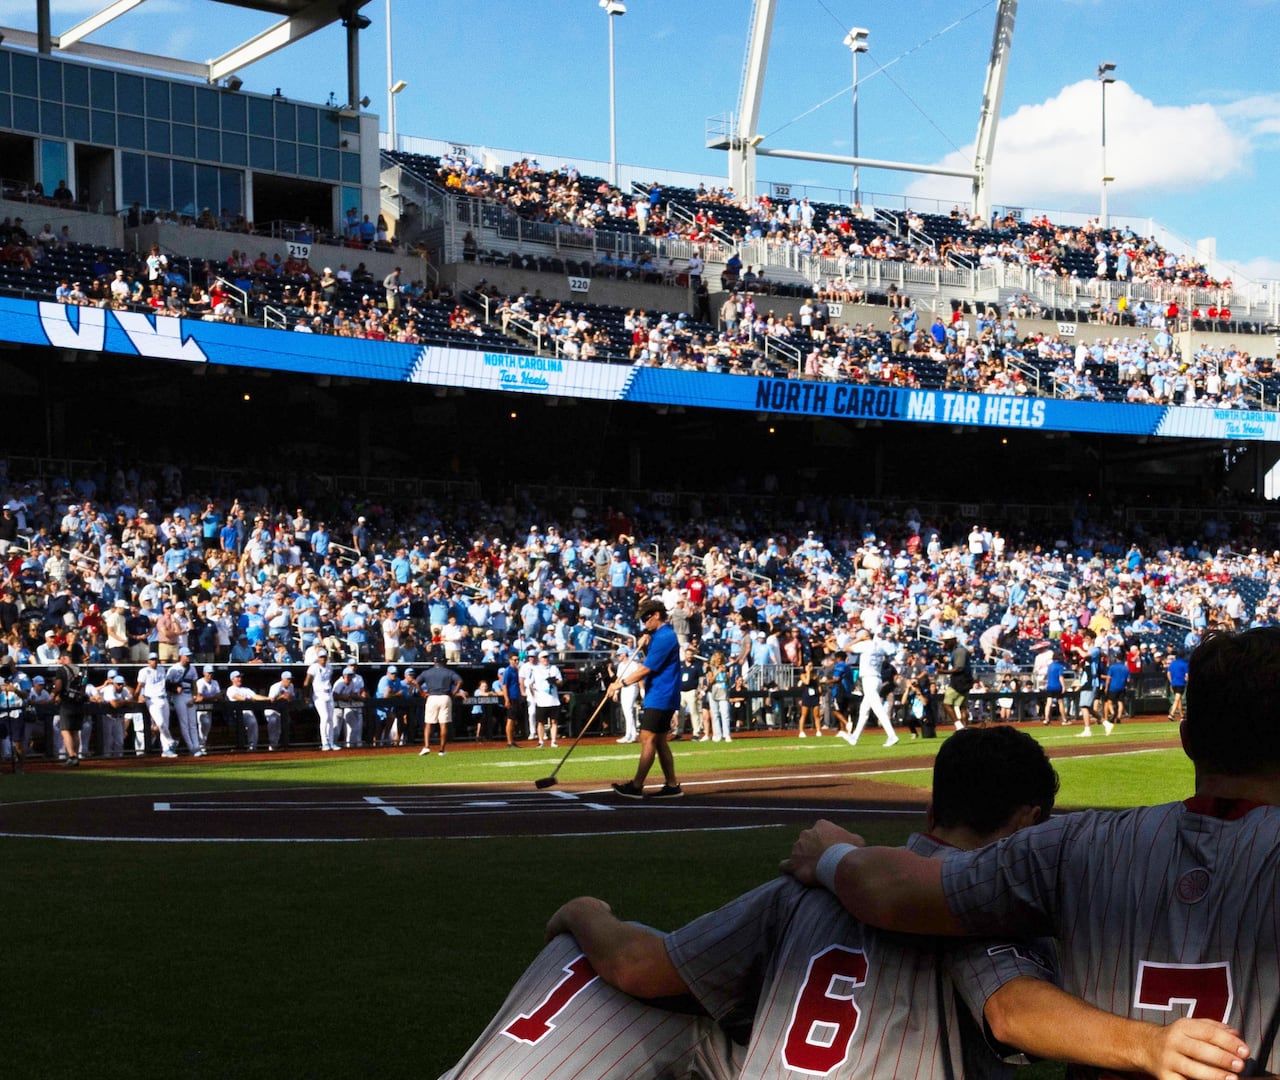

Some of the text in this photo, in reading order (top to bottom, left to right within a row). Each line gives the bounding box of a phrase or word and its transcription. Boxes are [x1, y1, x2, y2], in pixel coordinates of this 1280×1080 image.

[290, 245, 309, 257] 219
[571, 280, 588, 290] 220
[484, 353, 564, 373] NORTH CAROLINA
[499, 369, 518, 384] Tar
[755, 380, 827, 411] NORTH
[943, 393, 981, 423] TAR
[984, 396, 1047, 427] HEELS
[1214, 410, 1277, 423] NORTH CAROLINA
[500, 953, 600, 1046] 1
[1132, 960, 1234, 1023] 7
[781, 943, 870, 1077] 6
